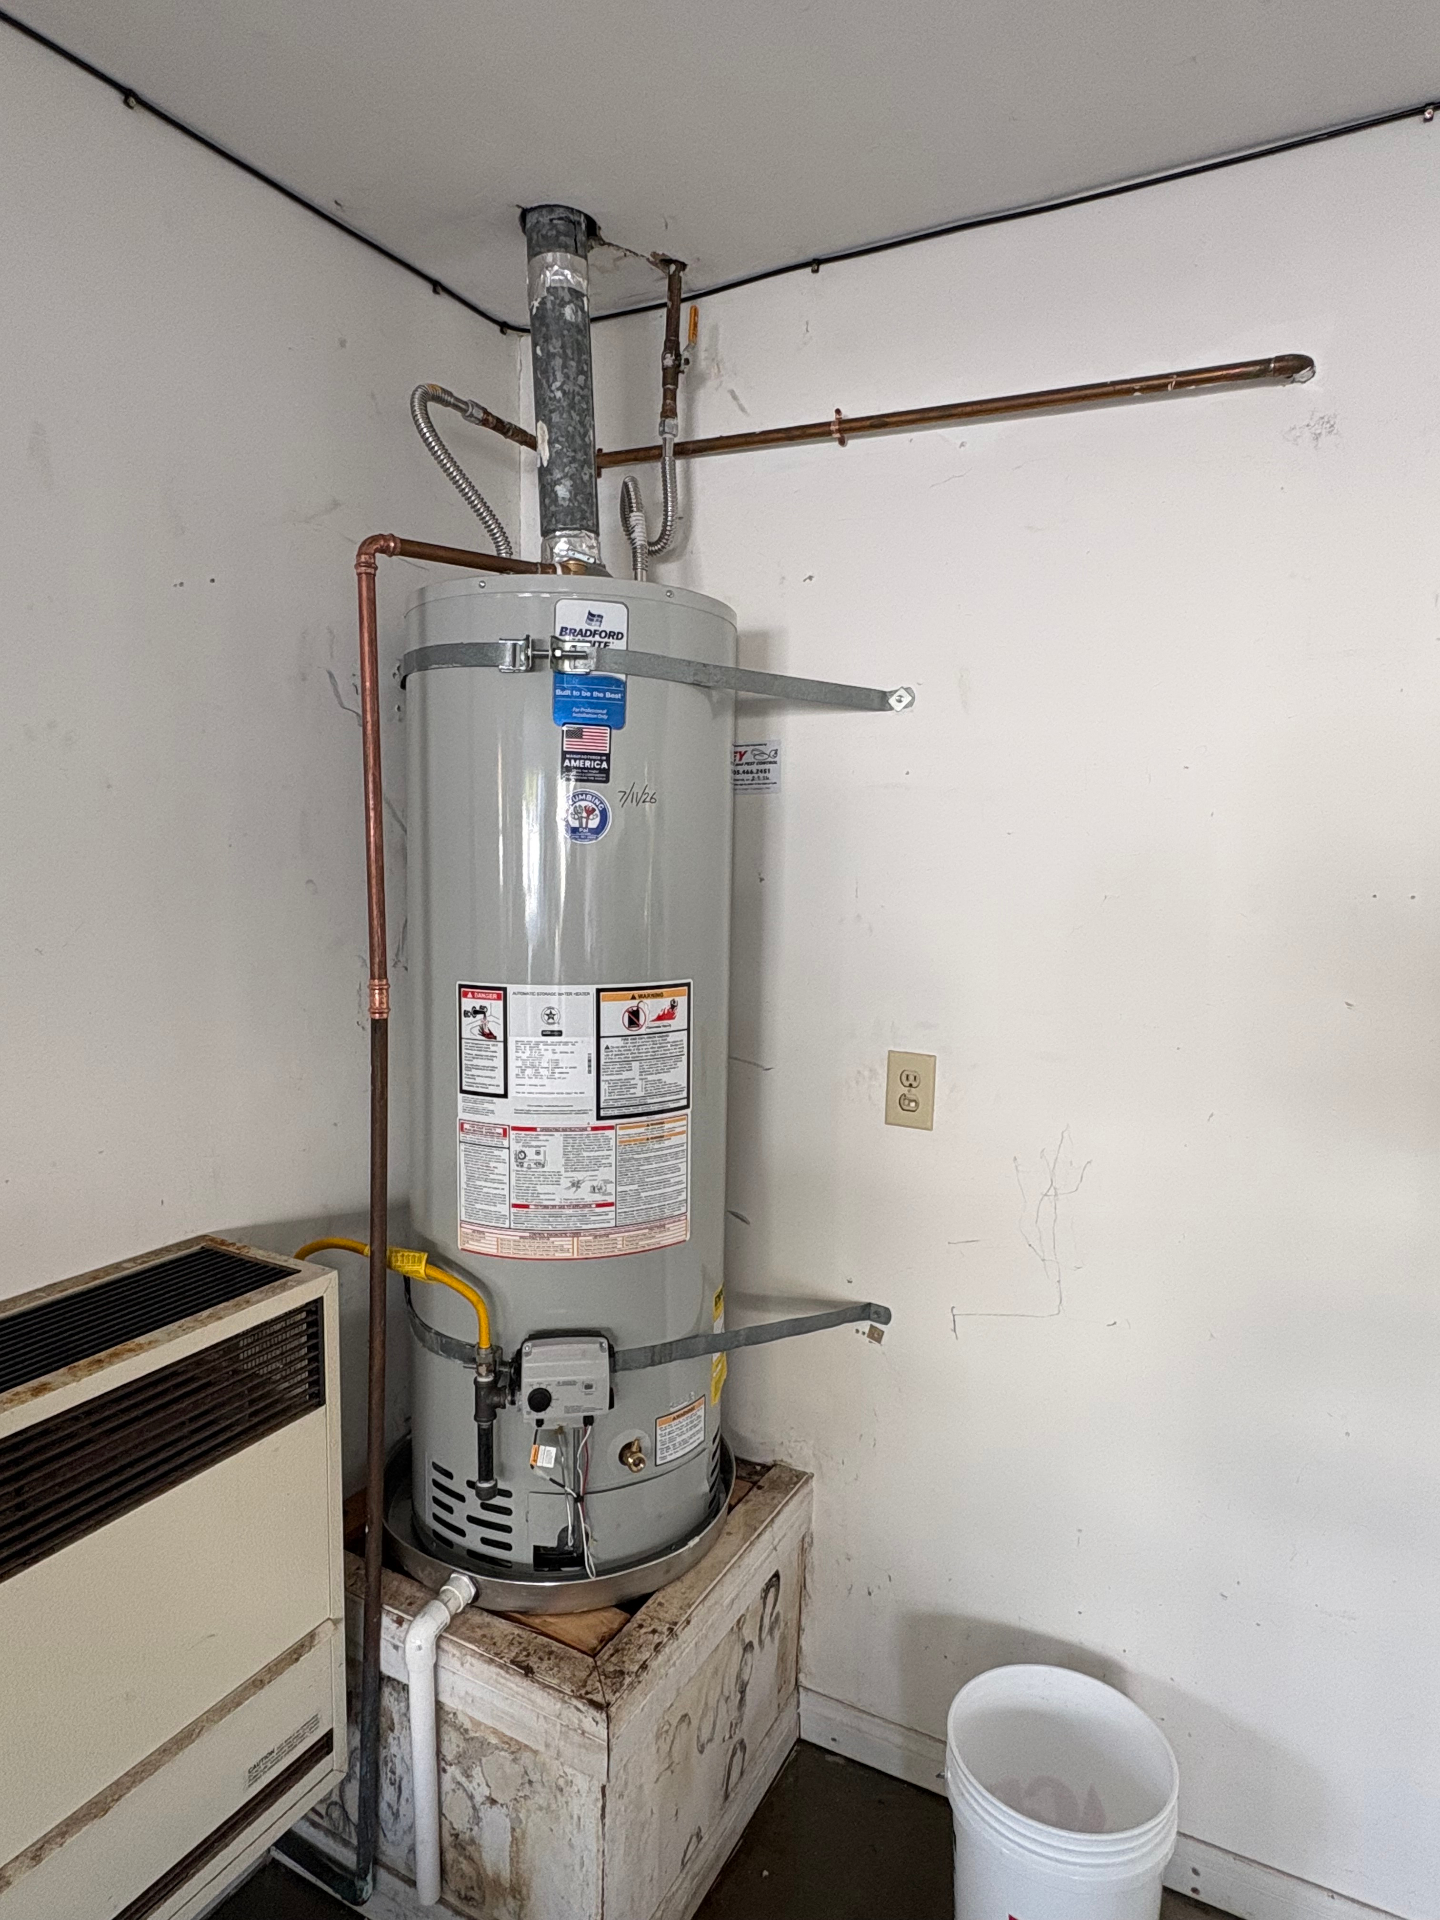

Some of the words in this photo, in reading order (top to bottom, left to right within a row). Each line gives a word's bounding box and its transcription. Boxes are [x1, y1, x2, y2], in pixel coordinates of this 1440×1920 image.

[559, 626, 624, 641] BRADFORD
[563, 759, 608, 769] AMERICA
[618, 782, 657, 808] 7/11/26
[248, 1746, 275, 1774] CAUTION
